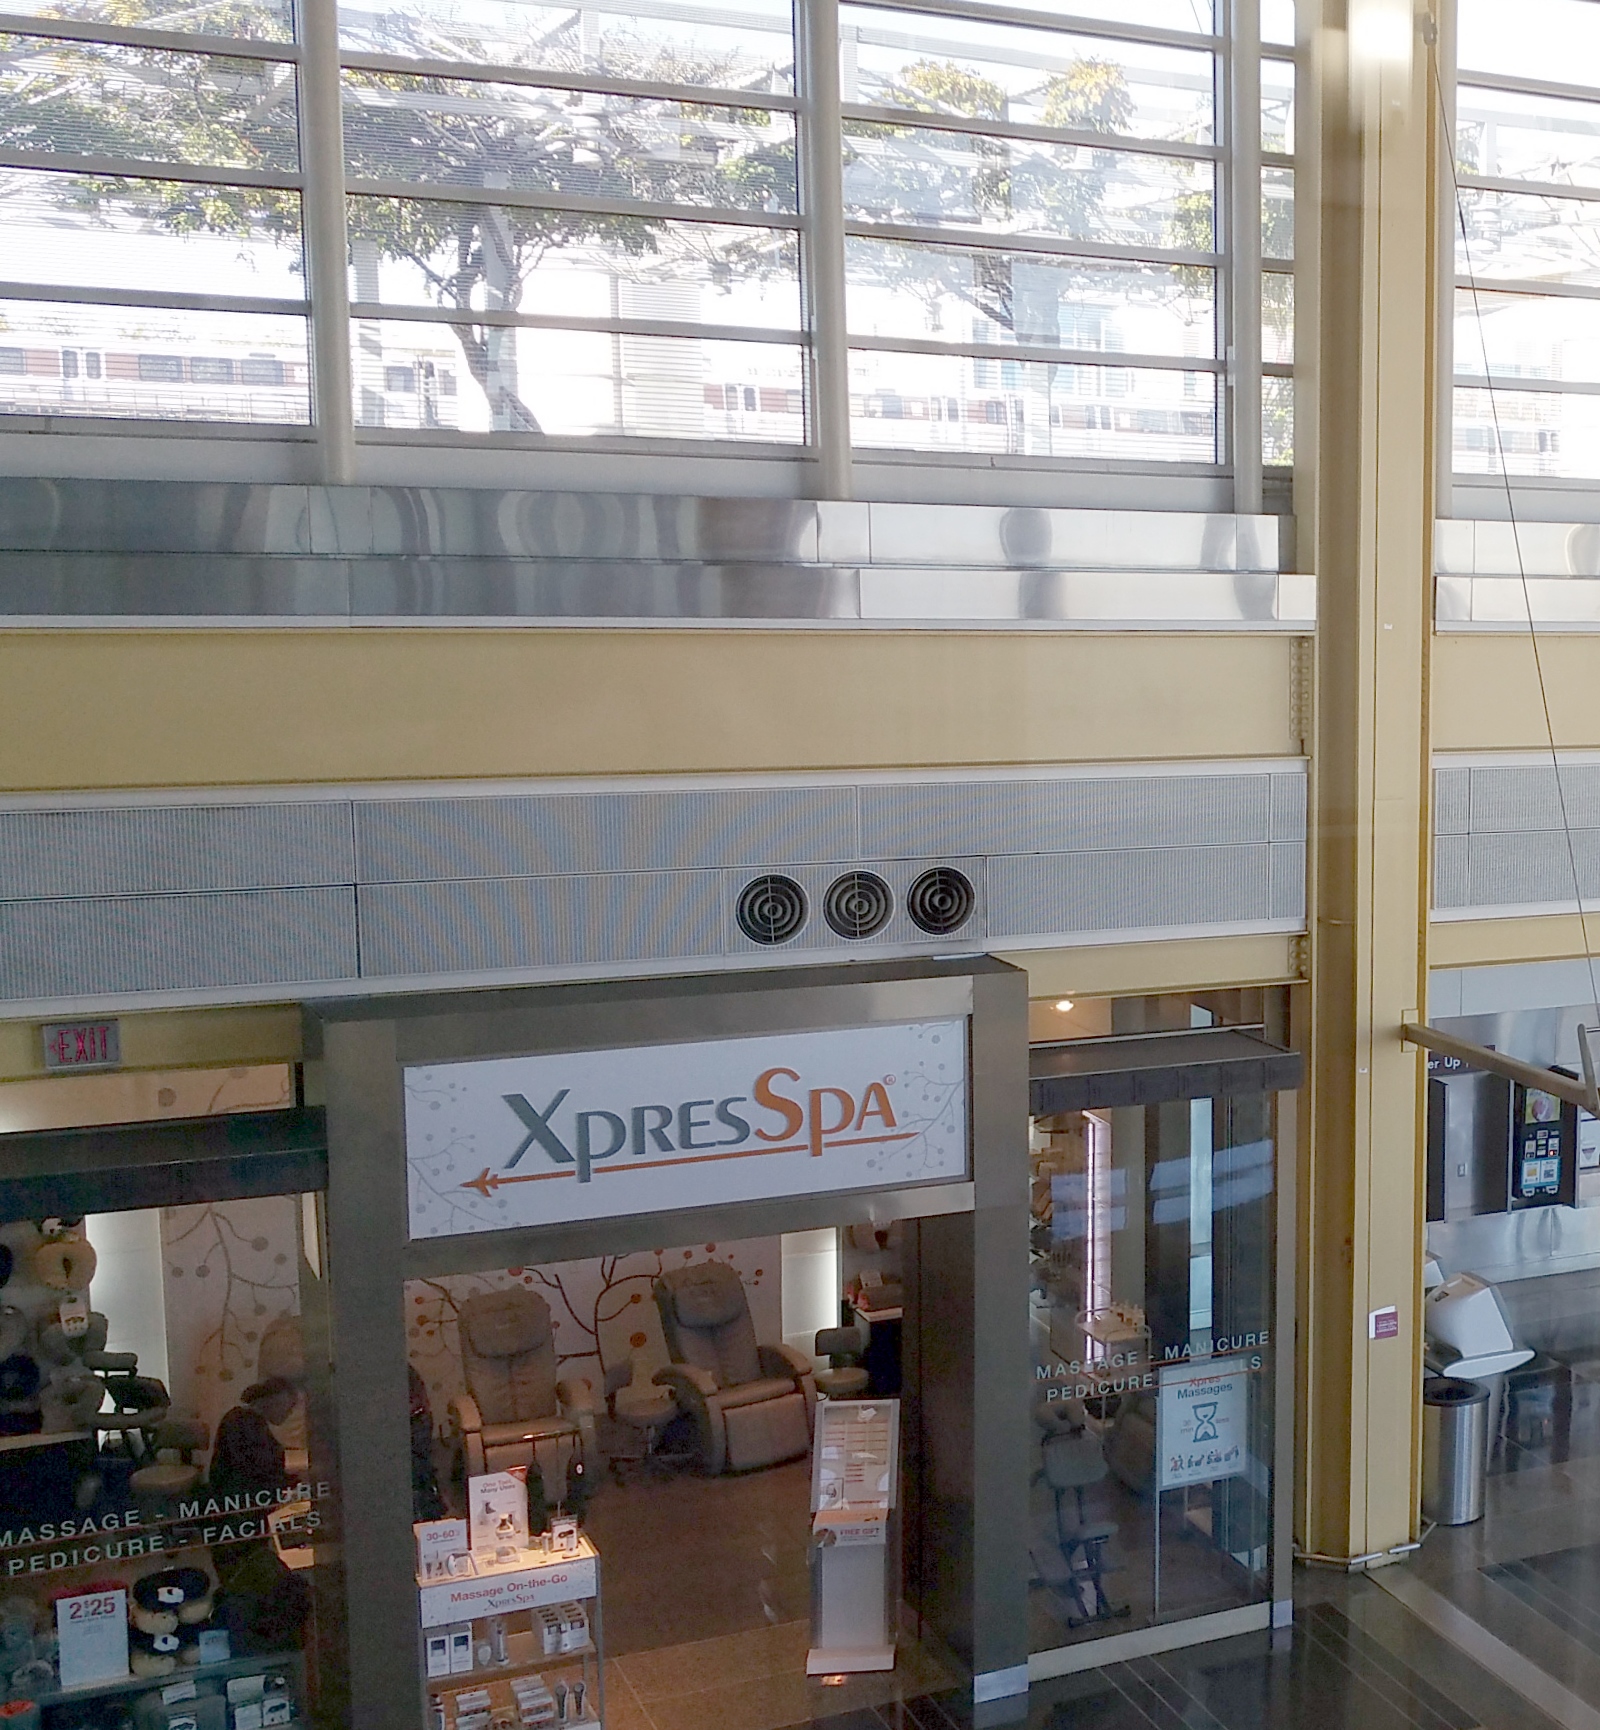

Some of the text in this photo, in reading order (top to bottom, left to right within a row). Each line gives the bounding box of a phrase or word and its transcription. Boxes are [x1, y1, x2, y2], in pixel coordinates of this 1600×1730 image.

[58, 1026, 109, 1063] EXIT
[1444, 1056, 1460, 1070] Up
[1036, 1352, 1138, 1380] MASAGE
[1165, 1330, 1270, 1360] MANICURE
[1046, 1373, 1153, 1403] PEDICURE
[1177, 1383, 1233, 1400] Massages
[179, 1481, 331, 1519] MANICURE
[8, 1536, 165, 1576] PEDICURE
[203, 1511, 321, 1544] FACIALS
[450, 1573, 568, 1603] Massage On-the-Go
